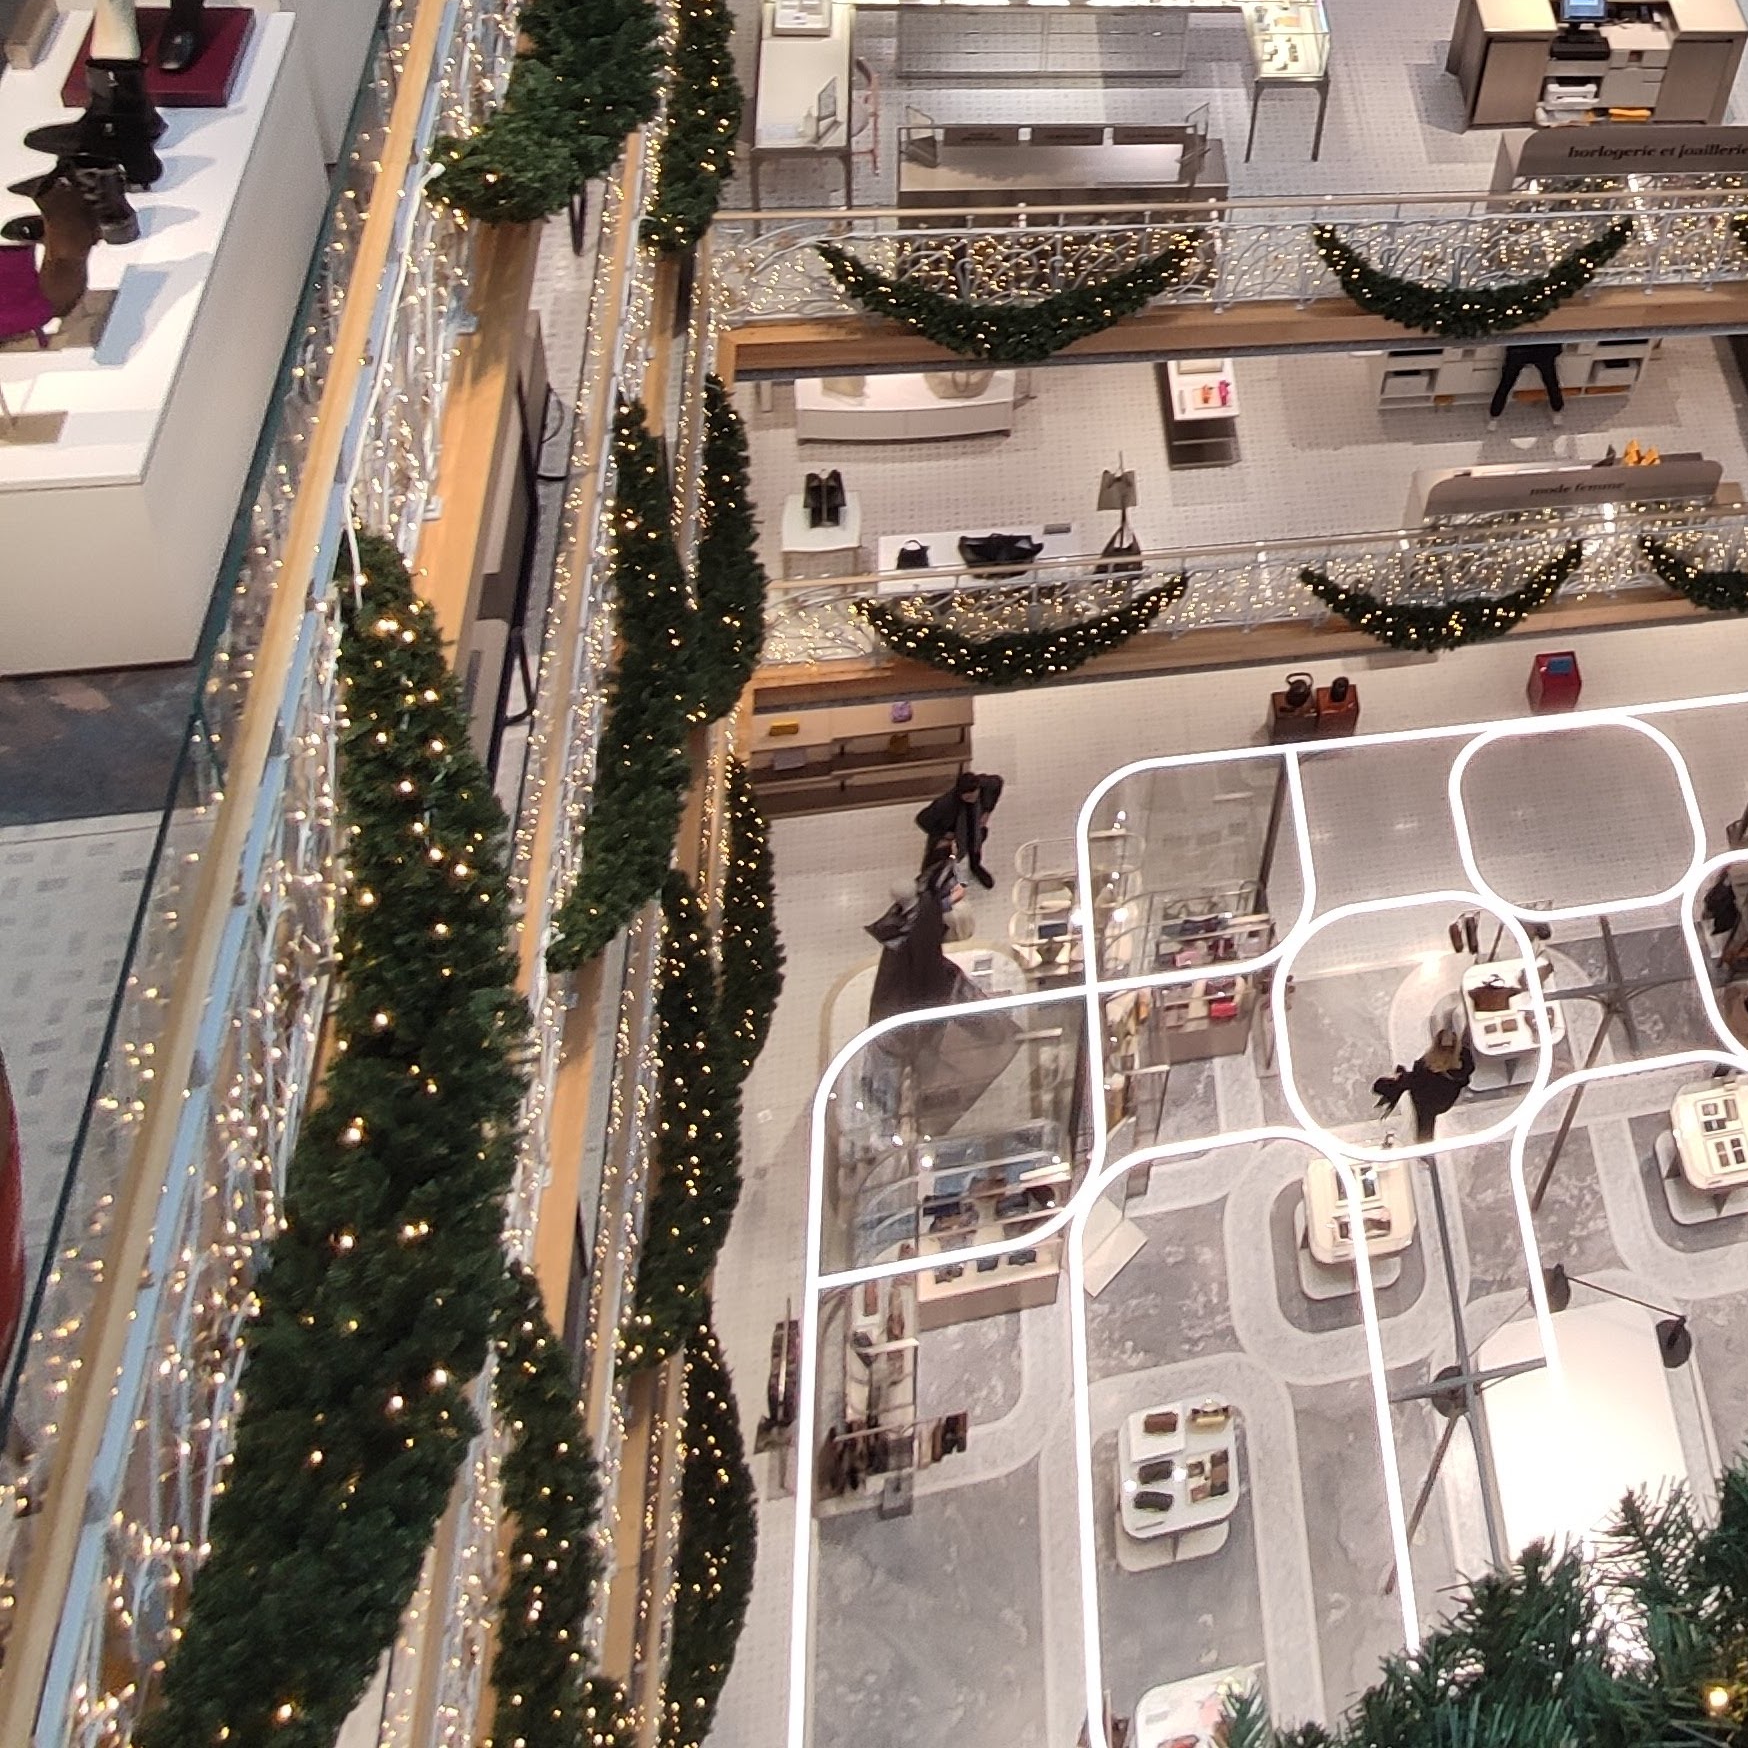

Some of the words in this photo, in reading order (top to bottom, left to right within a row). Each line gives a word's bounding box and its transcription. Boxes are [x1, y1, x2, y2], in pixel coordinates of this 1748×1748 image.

[1567, 145, 1656, 160] horlogerie
[1659, 146, 1676, 156] et
[1530, 484, 1571, 496] mode
[1574, 482, 1625, 492] femme
